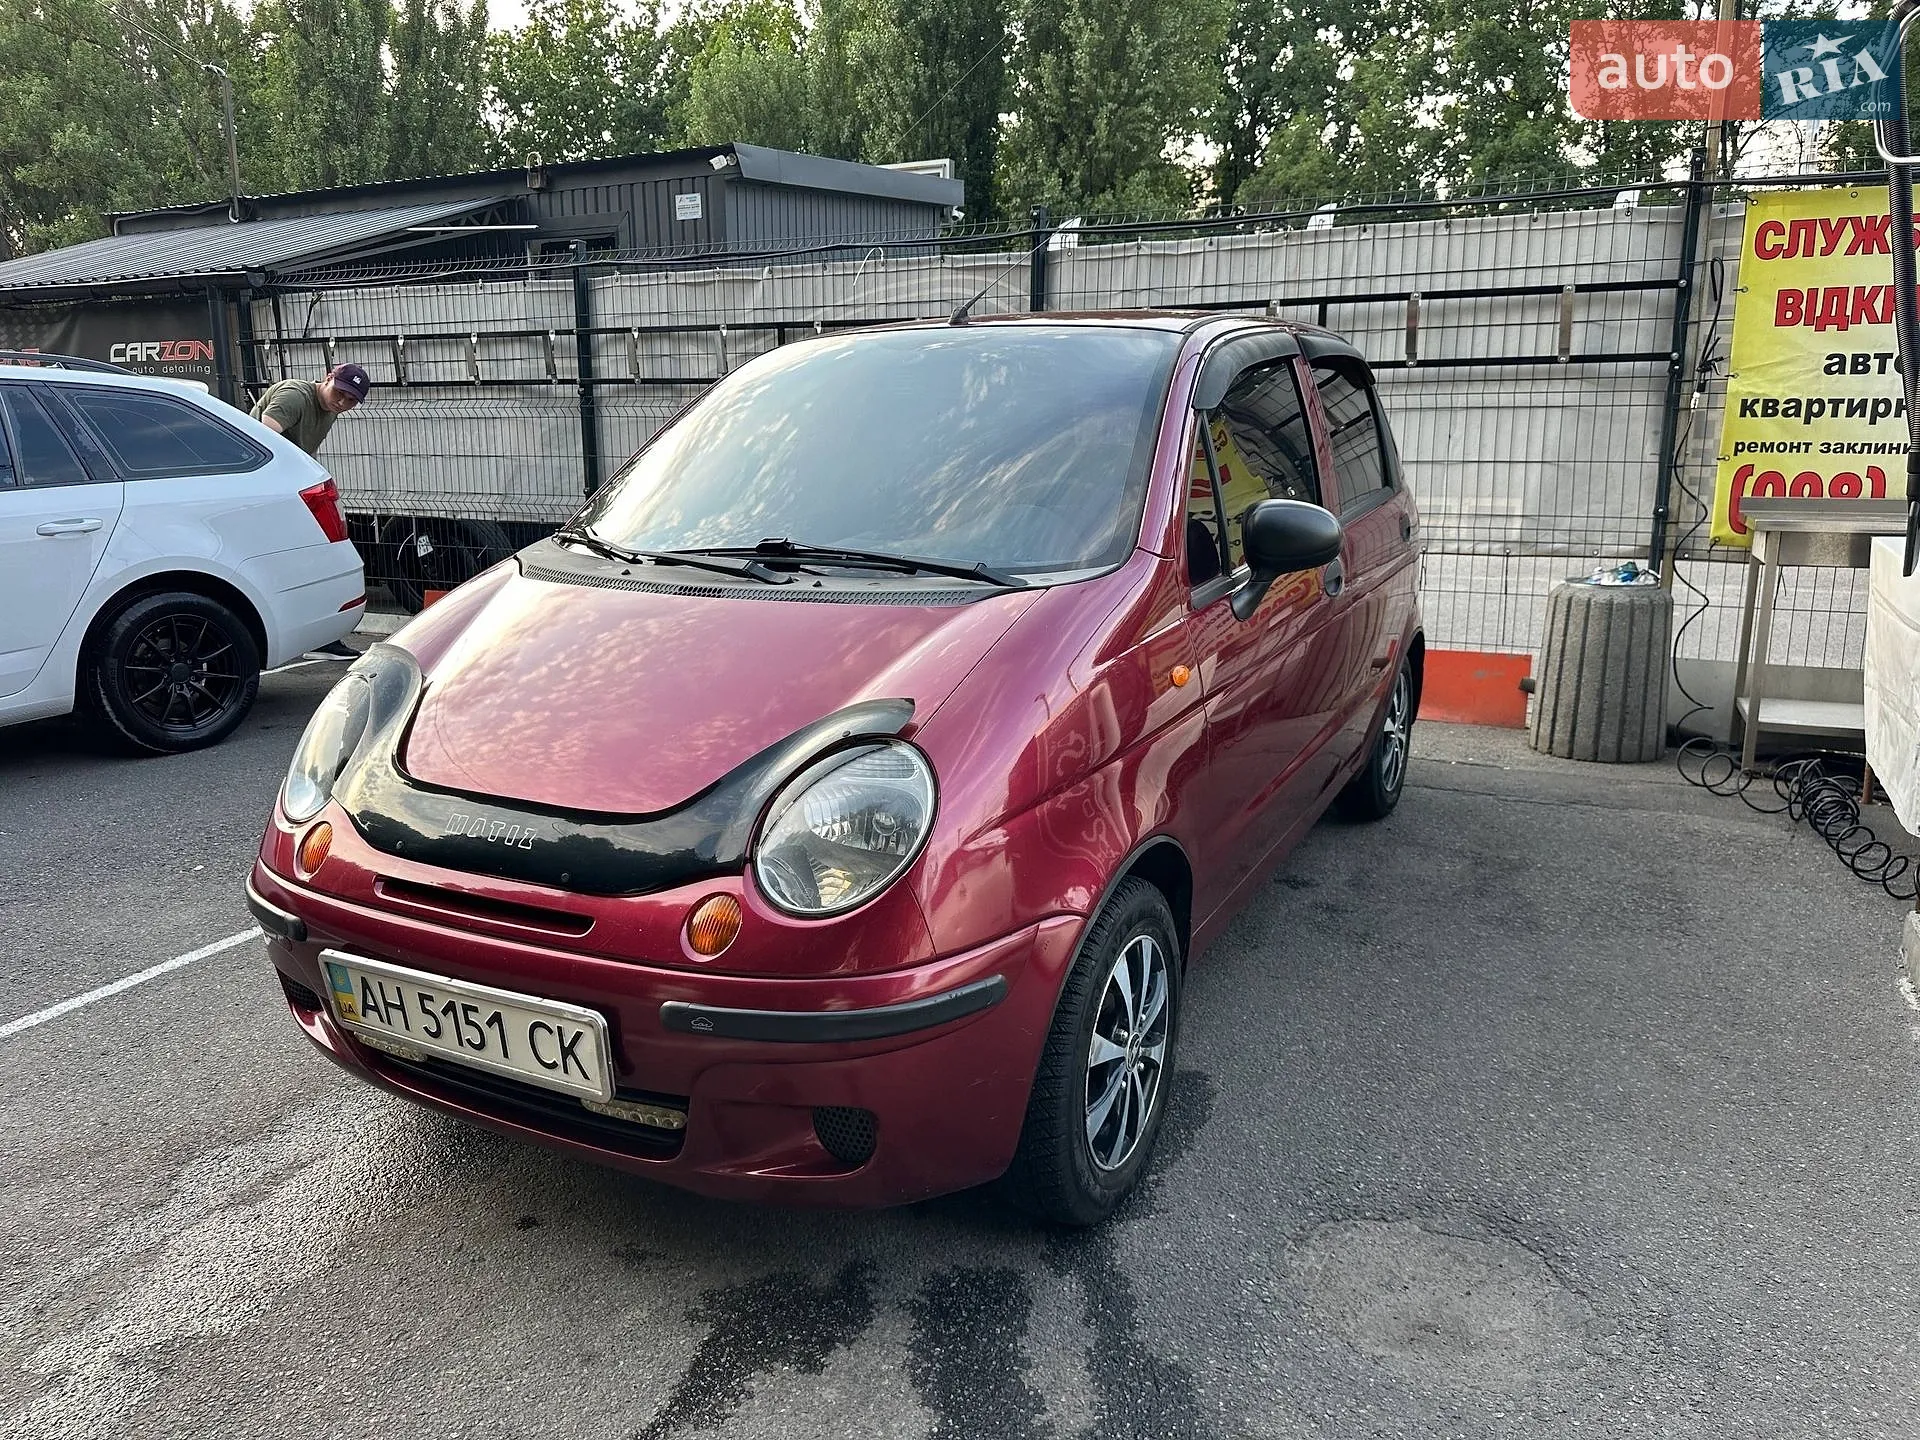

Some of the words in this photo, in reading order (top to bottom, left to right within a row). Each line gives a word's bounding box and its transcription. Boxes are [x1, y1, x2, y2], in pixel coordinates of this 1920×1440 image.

[1754, 214, 1920, 260] СЛУЖ
[110, 339, 214, 363] CARZON
[162, 364, 211, 375] detailing
[1733, 441, 1812, 456] ремонт
[445, 813, 537, 850] MATIZ
[360, 976, 410, 1032] AH
[417, 992, 510, 1059] 5151
[528, 1020, 591, 1081] CK
